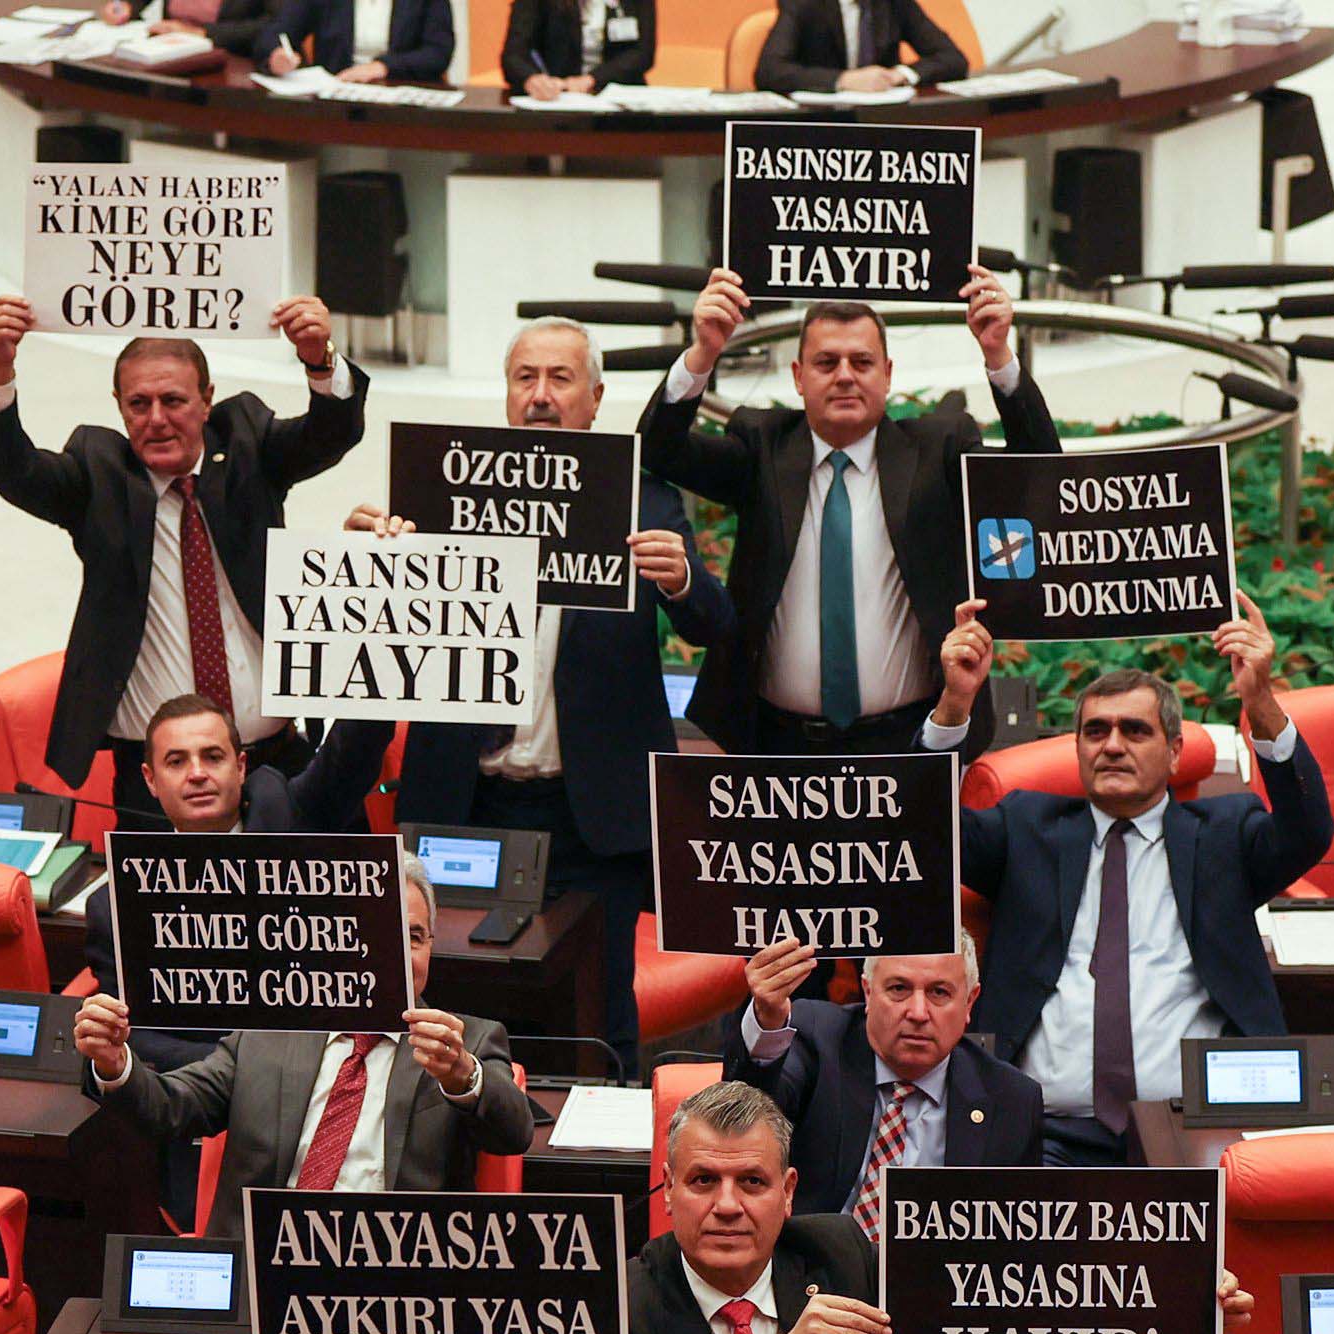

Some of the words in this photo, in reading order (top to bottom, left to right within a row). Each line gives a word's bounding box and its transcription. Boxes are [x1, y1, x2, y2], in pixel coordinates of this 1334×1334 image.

[736, 147, 873, 183] BASINSIZ
[879, 149, 969, 185] BASIN
[39, 197, 148, 236] KİME
[164, 200, 273, 237] GÖRE
[772, 196, 929, 236] YASASINA
[88, 240, 222, 277] NEYE
[768, 245, 931, 290] HAYIR!
[62, 276, 244, 330] GÖRE?
[442, 441, 581, 492] ÖZGÜR
[1058, 472, 1190, 515] SOSYAL
[450, 496, 570, 539] BASIN
[1039, 522, 1218, 566] MEDYAMA
[302, 546, 503, 592] SANSÜR
[276, 595, 522, 639] YASASINA
[1043, 575, 1223, 618] DOKUNMA
[272, 640, 524, 706] HAYIR
[708, 766, 901, 819] SANSÜR
[688, 840, 923, 884] YASASINA
[153, 906, 248, 951] KİME
[258, 908, 369, 958] GÖRE,
[733, 907, 883, 949] HAYIR
[150, 968, 249, 1005] NEYE
[259, 963, 376, 1008] GÖRE?
[894, 1200, 1077, 1242] BASINSIZ
[1088, 1202, 1210, 1243] BASIN
[945, 1263, 1157, 1309] YASASINA
